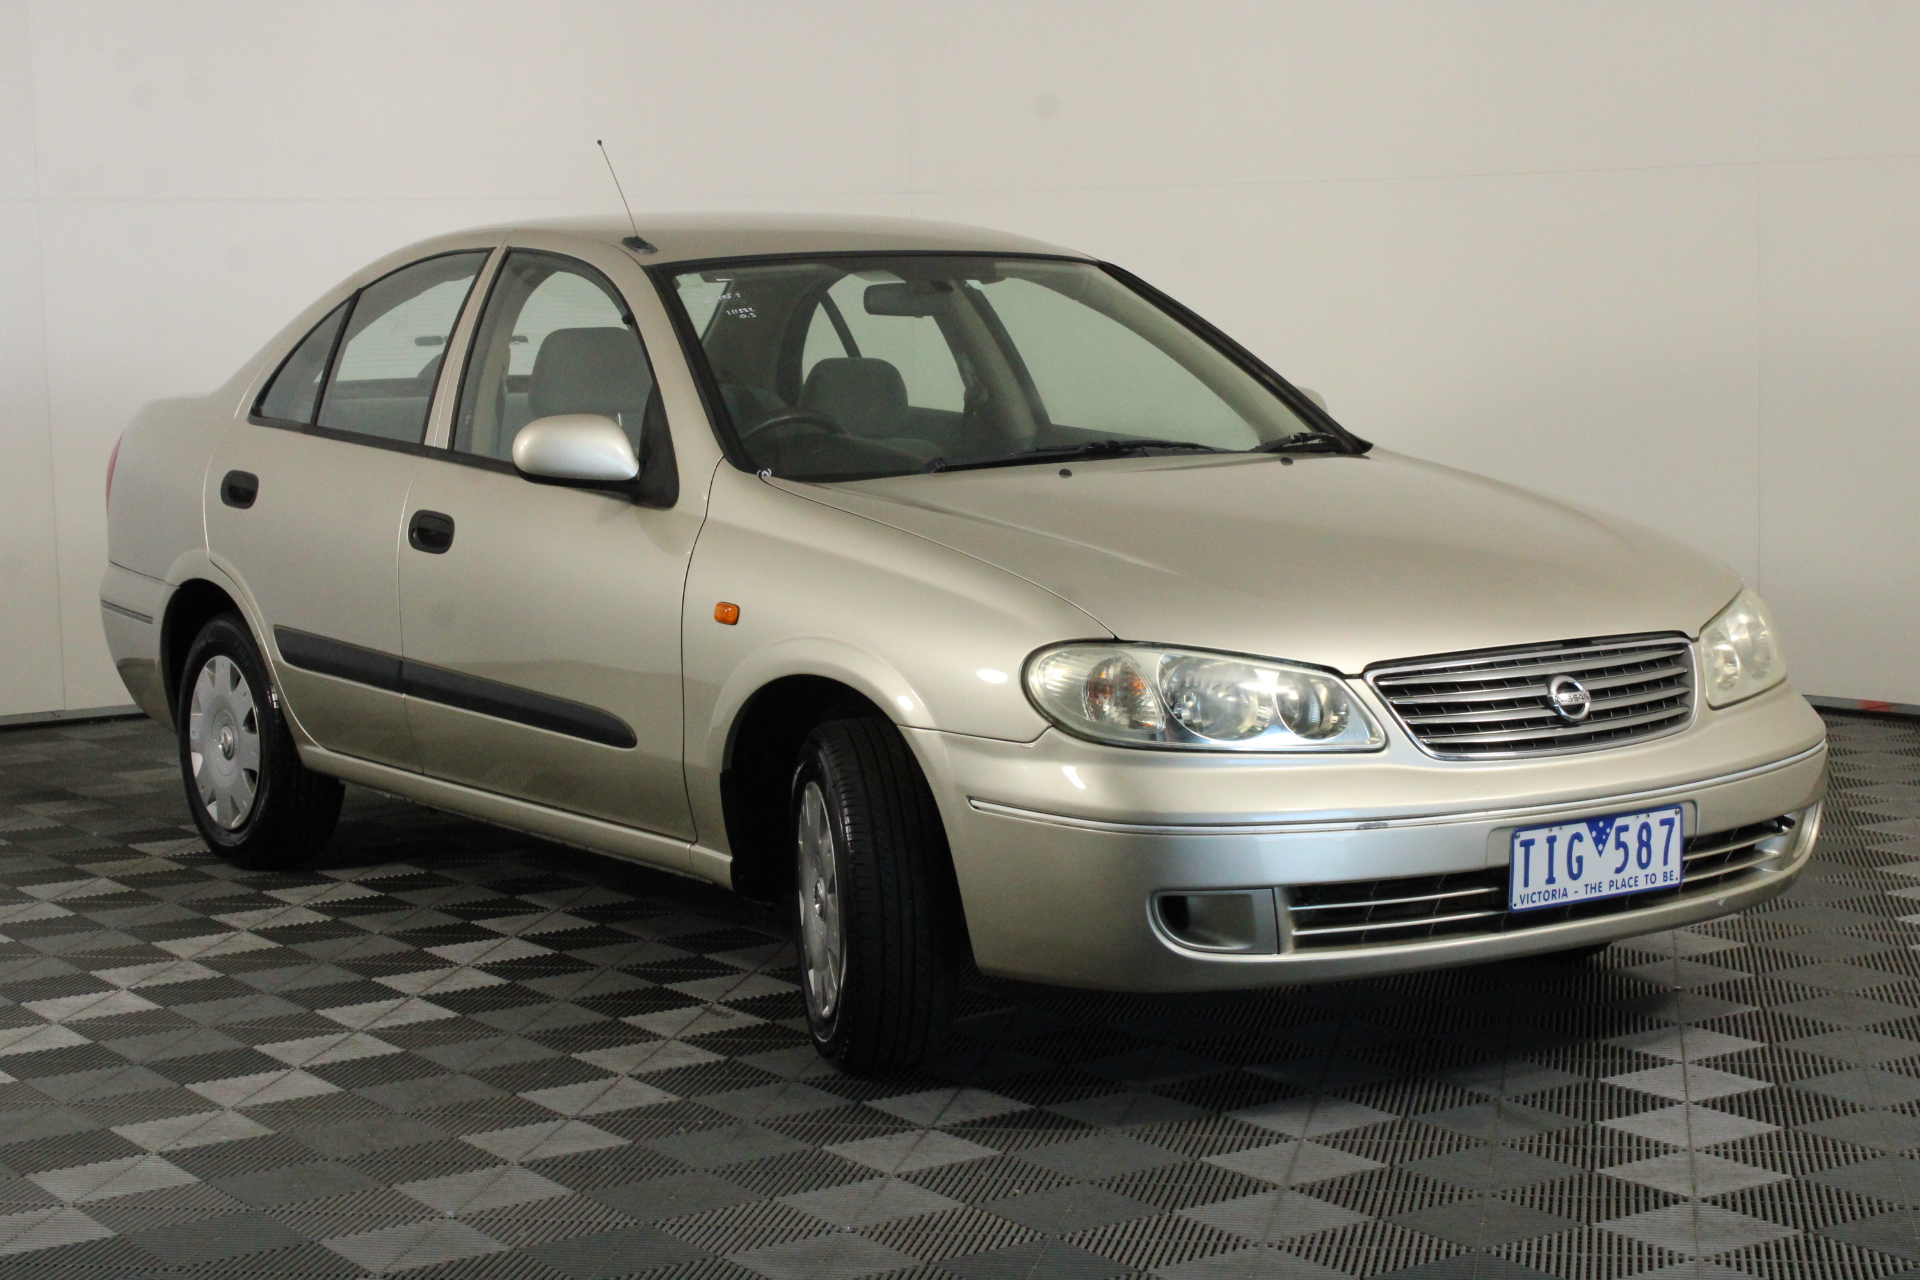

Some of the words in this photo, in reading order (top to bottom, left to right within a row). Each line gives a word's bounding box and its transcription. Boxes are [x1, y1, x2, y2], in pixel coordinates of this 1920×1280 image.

[1519, 832, 1584, 888] TIG
[1614, 817, 1675, 874] 587
[1519, 888, 1568, 905] VICTORIA
[1584, 883, 1603, 895] THE
[1608, 876, 1639, 891] PLACE
[1644, 873, 1657, 885] TO
